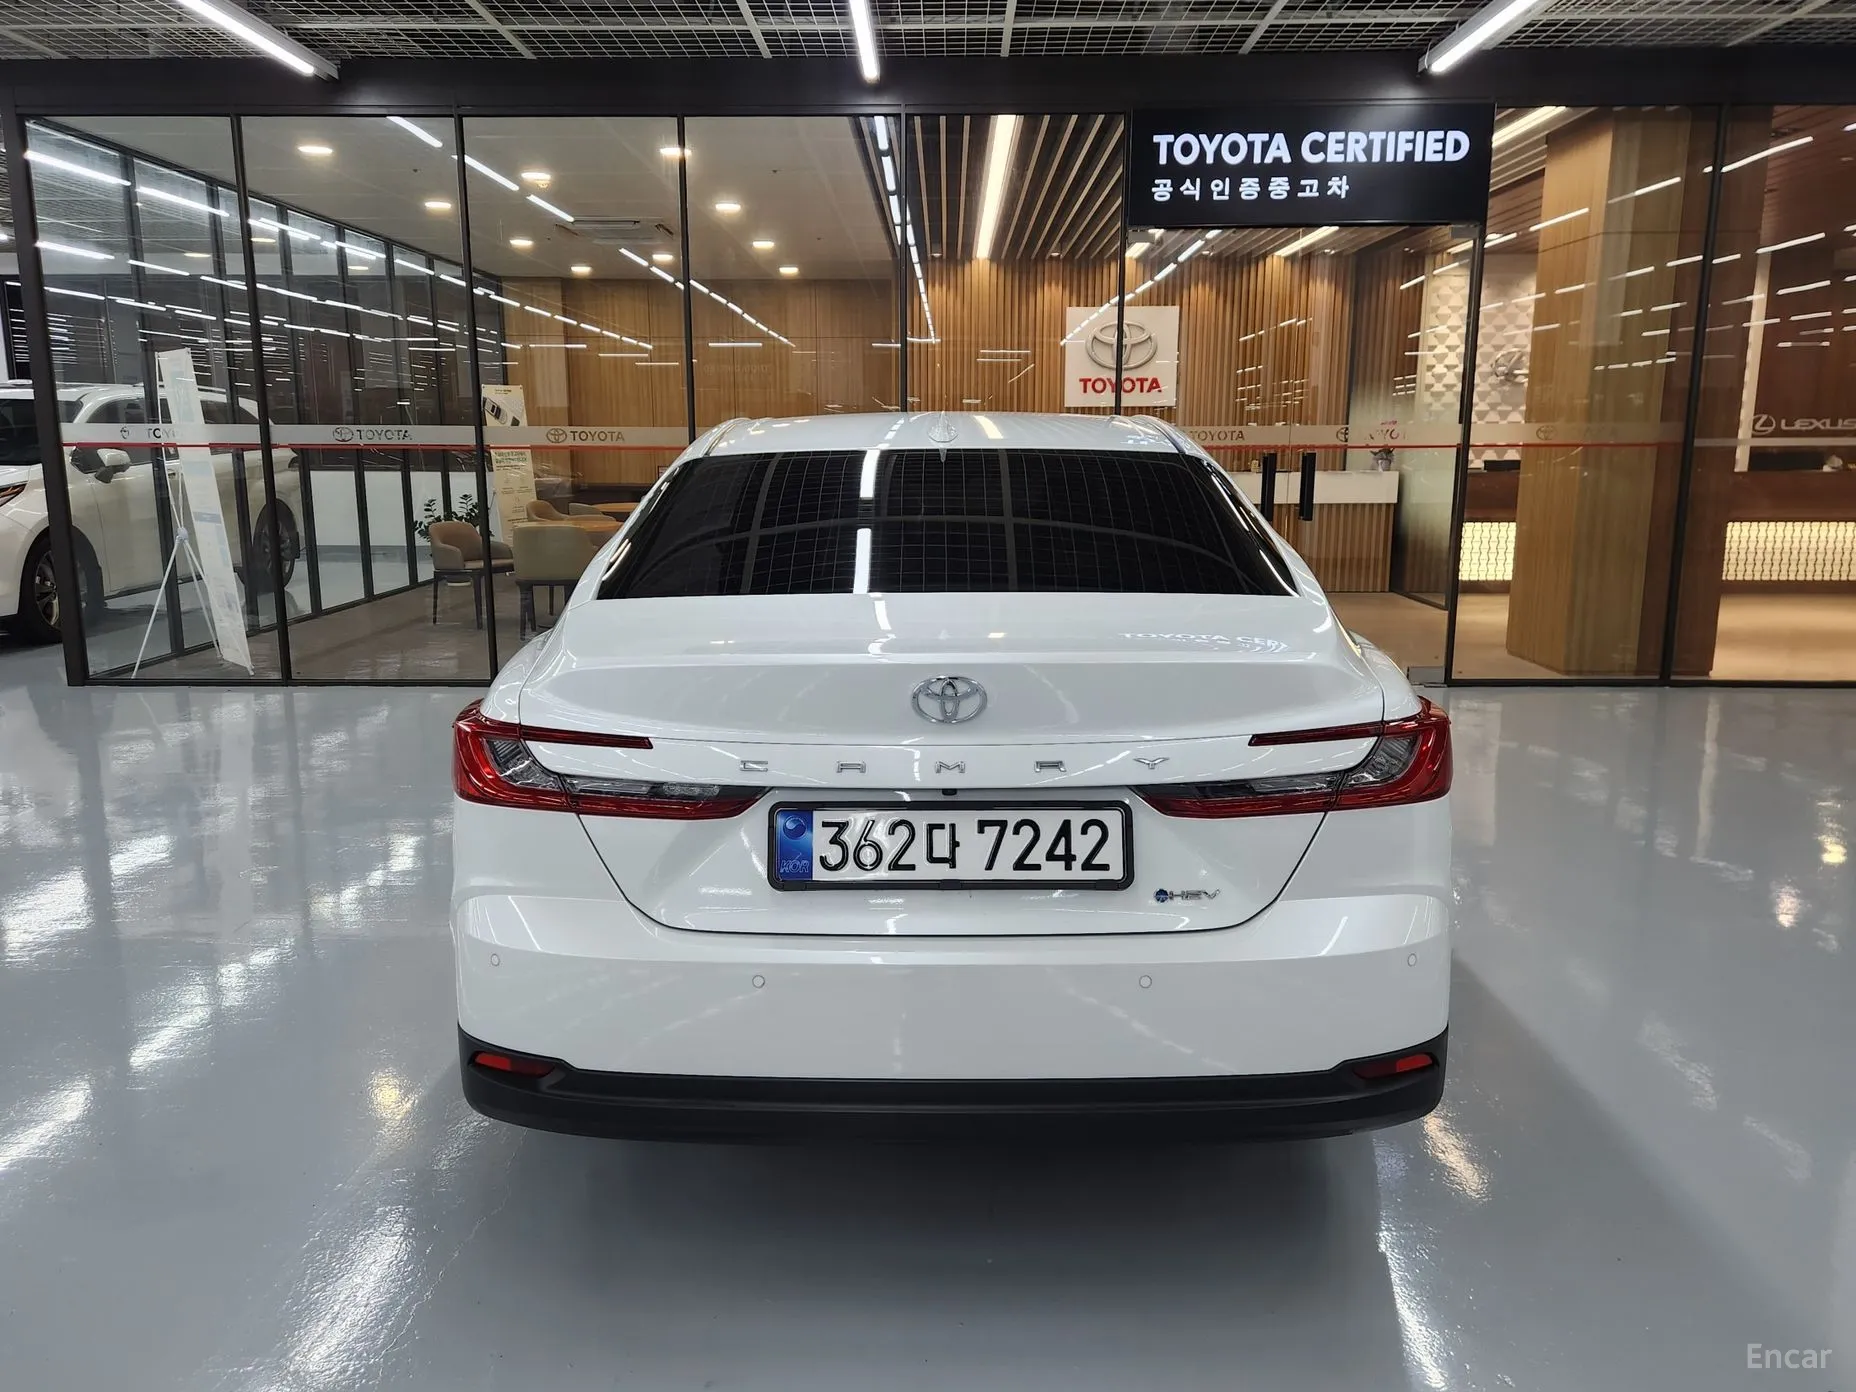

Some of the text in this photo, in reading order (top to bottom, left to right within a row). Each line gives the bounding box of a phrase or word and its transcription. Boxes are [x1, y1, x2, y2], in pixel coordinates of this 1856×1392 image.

[1153, 130, 1470, 165] TOYOTA CERTIFIED
[1781, 418, 1856, 430] LEXUS
[356, 429, 413, 441] TOYOTA
[570, 430, 625, 442] TOYOTA
[1190, 430, 1245, 441] TOYOTA
[739, 757, 1170, 774] CAMRY
[819, 818, 1110, 871] 362다 7242
[780, 859, 809, 873] KOR
